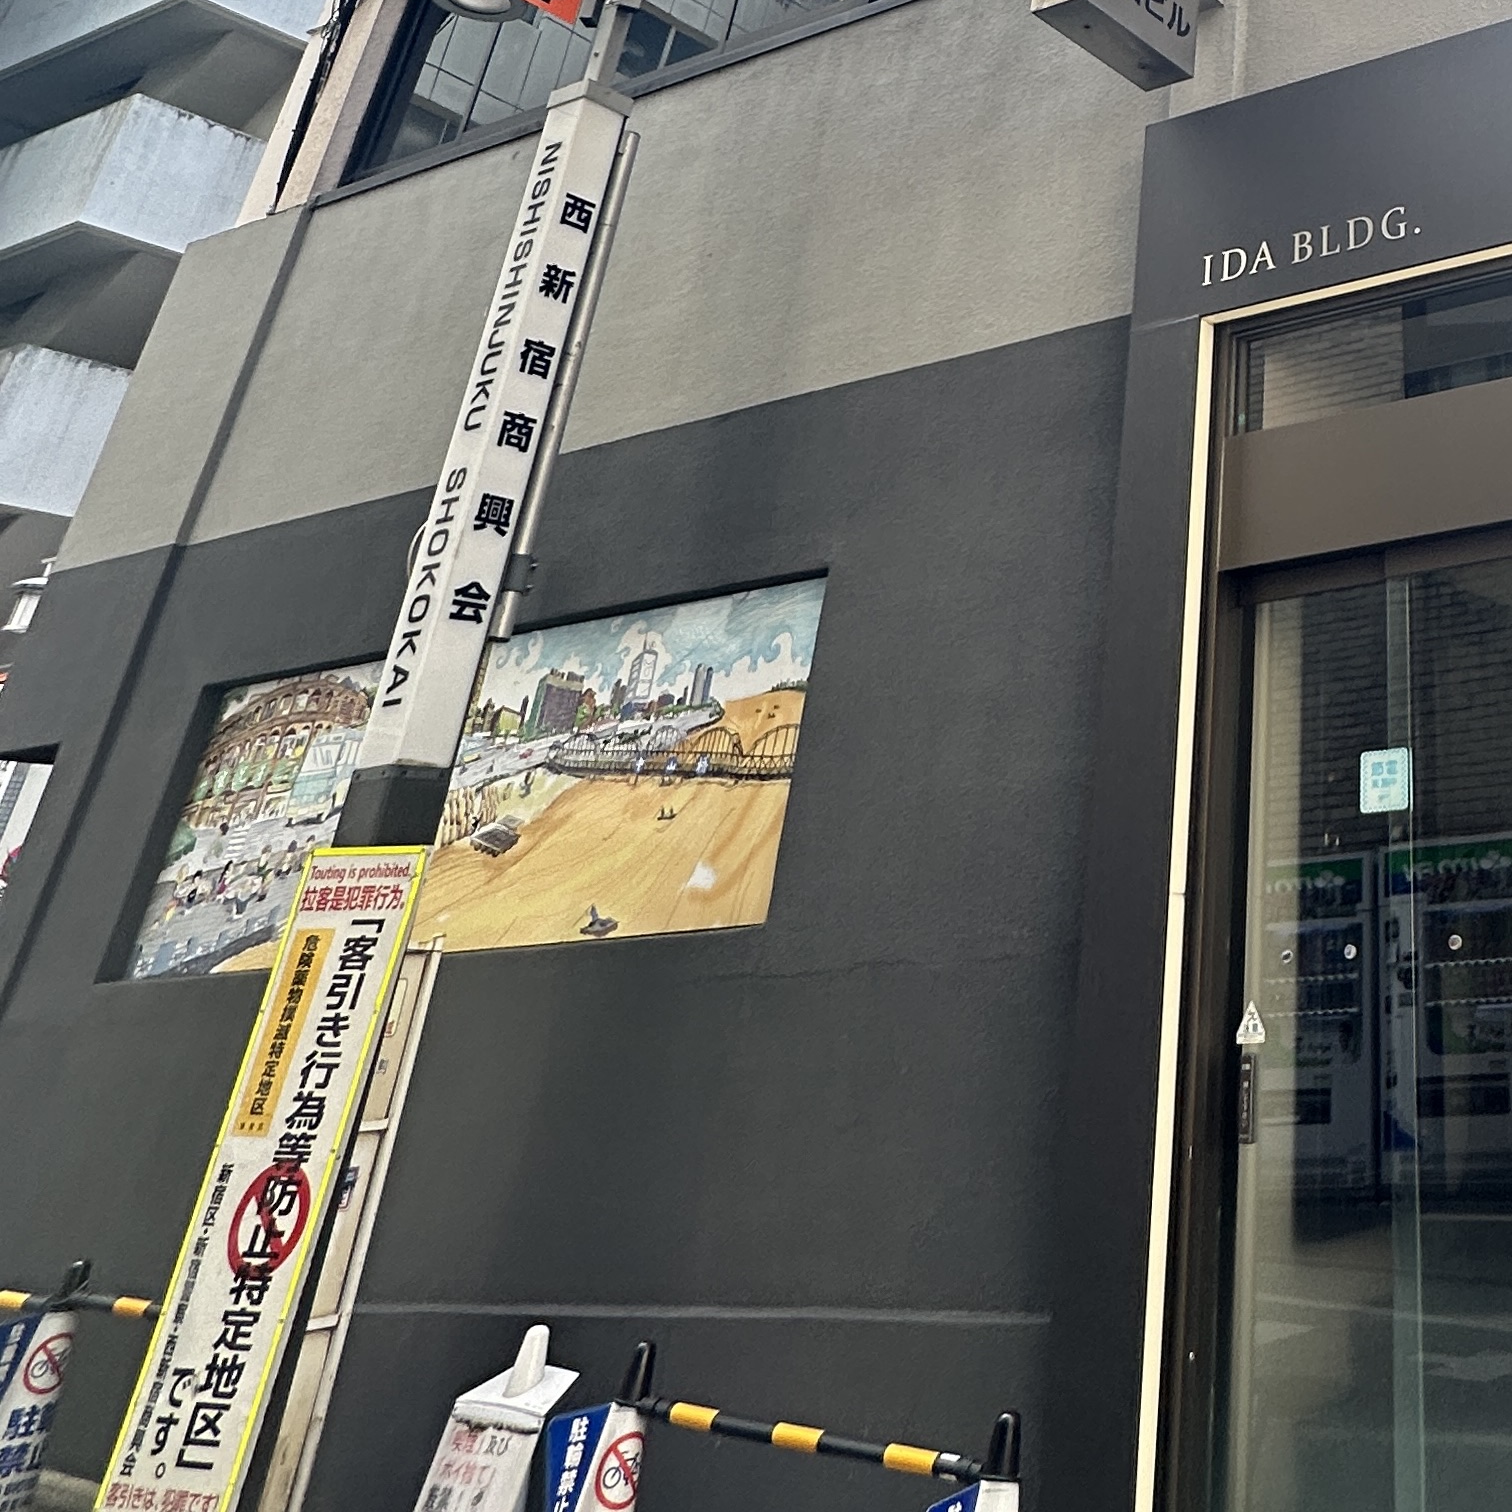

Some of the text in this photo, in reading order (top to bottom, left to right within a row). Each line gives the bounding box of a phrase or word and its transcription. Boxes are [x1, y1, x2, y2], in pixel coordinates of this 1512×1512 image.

[1202, 206, 1421, 287] IDA BLDG.
[381, 141, 563, 709] NISHISHINJUKU SHOKOKAI
[449, 192, 596, 625] 西新宿商興会
[310, 864, 347, 884] Touting
[349, 864, 358, 879] is
